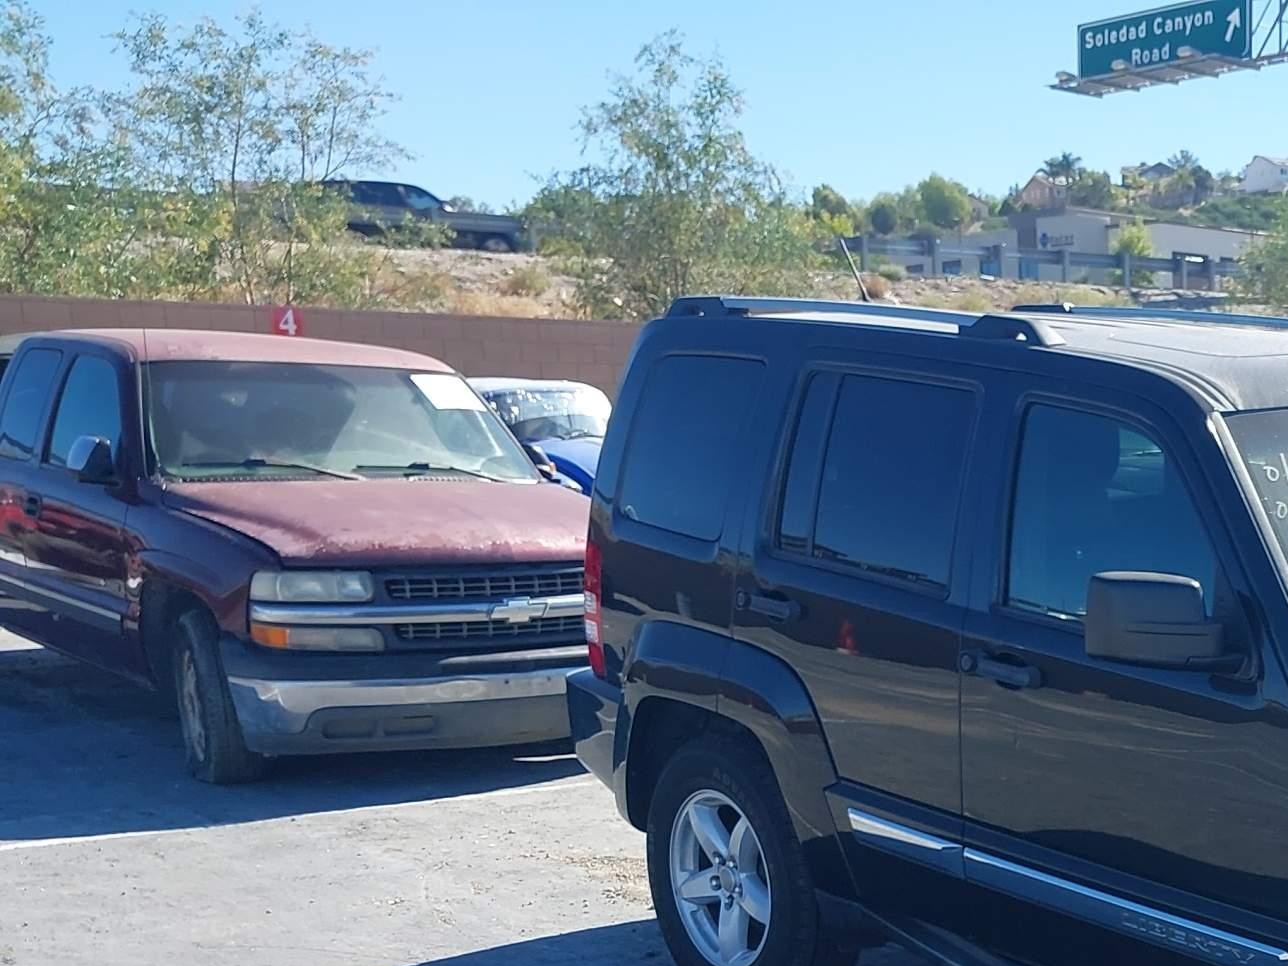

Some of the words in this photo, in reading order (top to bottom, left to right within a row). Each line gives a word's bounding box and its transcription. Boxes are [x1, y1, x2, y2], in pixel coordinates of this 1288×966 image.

[1085, 20, 1147, 49] Soledad
[1153, 10, 1213, 36] Canyon
[1131, 43, 1170, 65] Road
[279, 309, 297, 336] 4
[1122, 911, 1256, 965] LIBERTY
